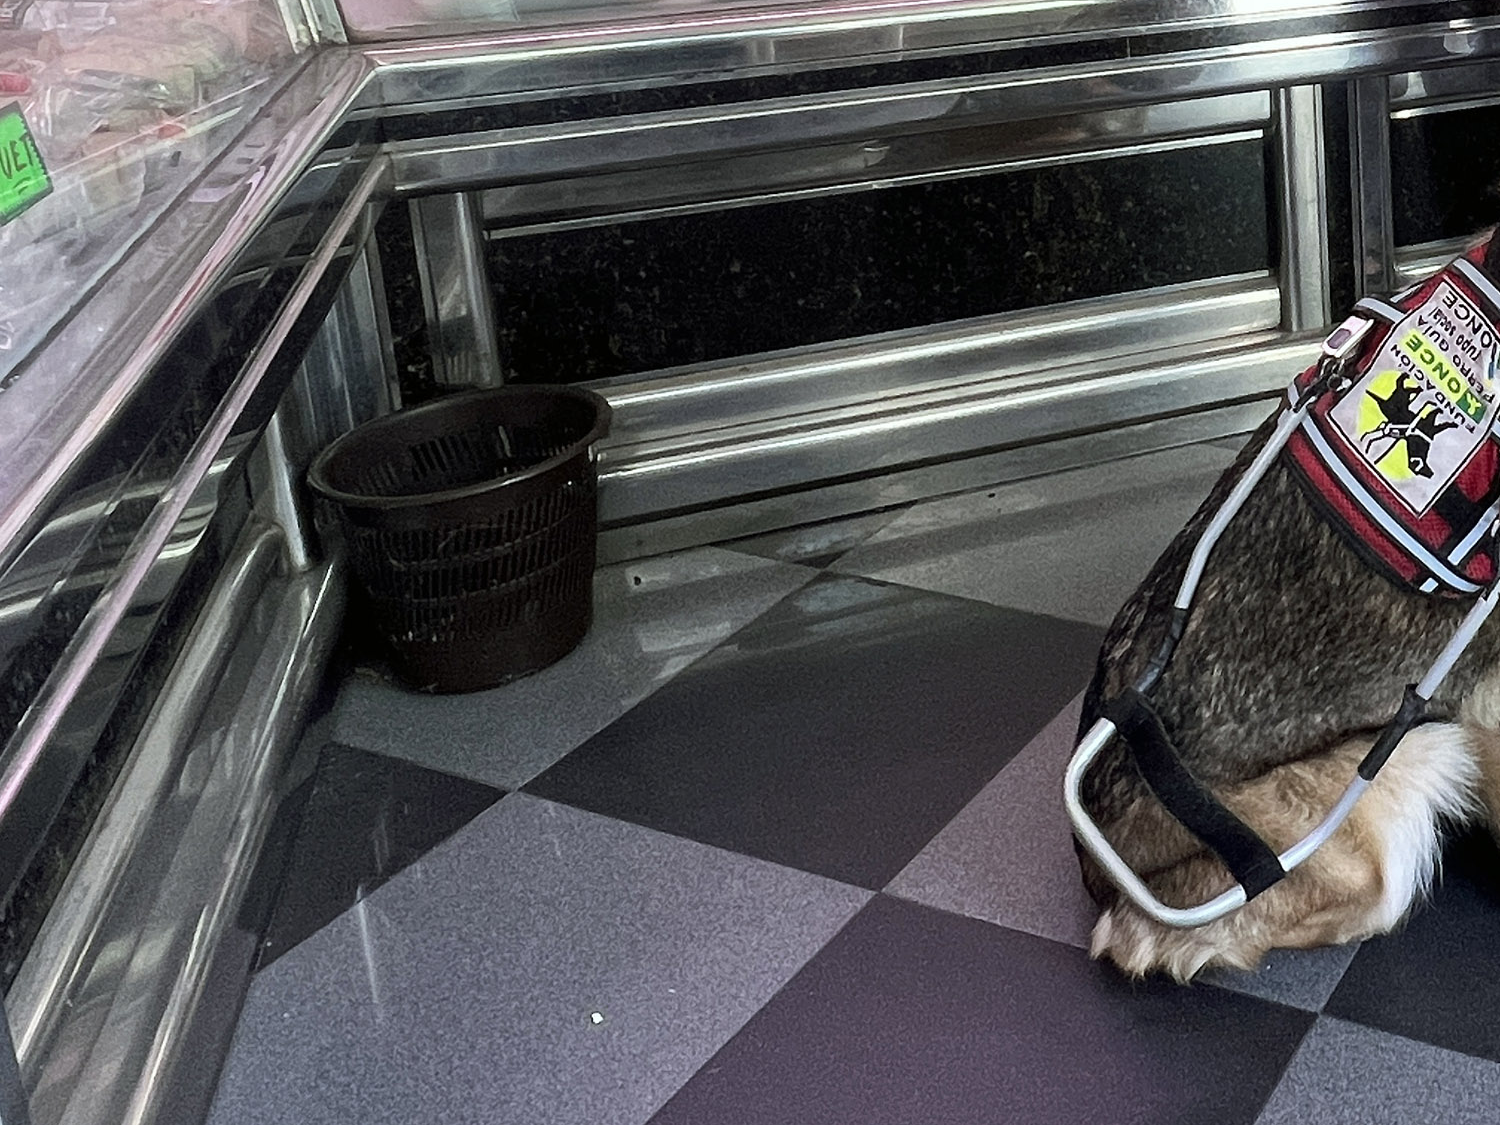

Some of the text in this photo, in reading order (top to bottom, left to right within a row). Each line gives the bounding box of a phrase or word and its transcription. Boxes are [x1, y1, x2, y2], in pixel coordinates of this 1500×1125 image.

[1428, 307, 1456, 336] social
[1442, 290, 1492, 348] ONCE
[1390, 344, 1476, 434] FUNDACIÓN
[1405, 334, 1461, 394] ONCE
[1452, 354, 1495, 404] PERRO
